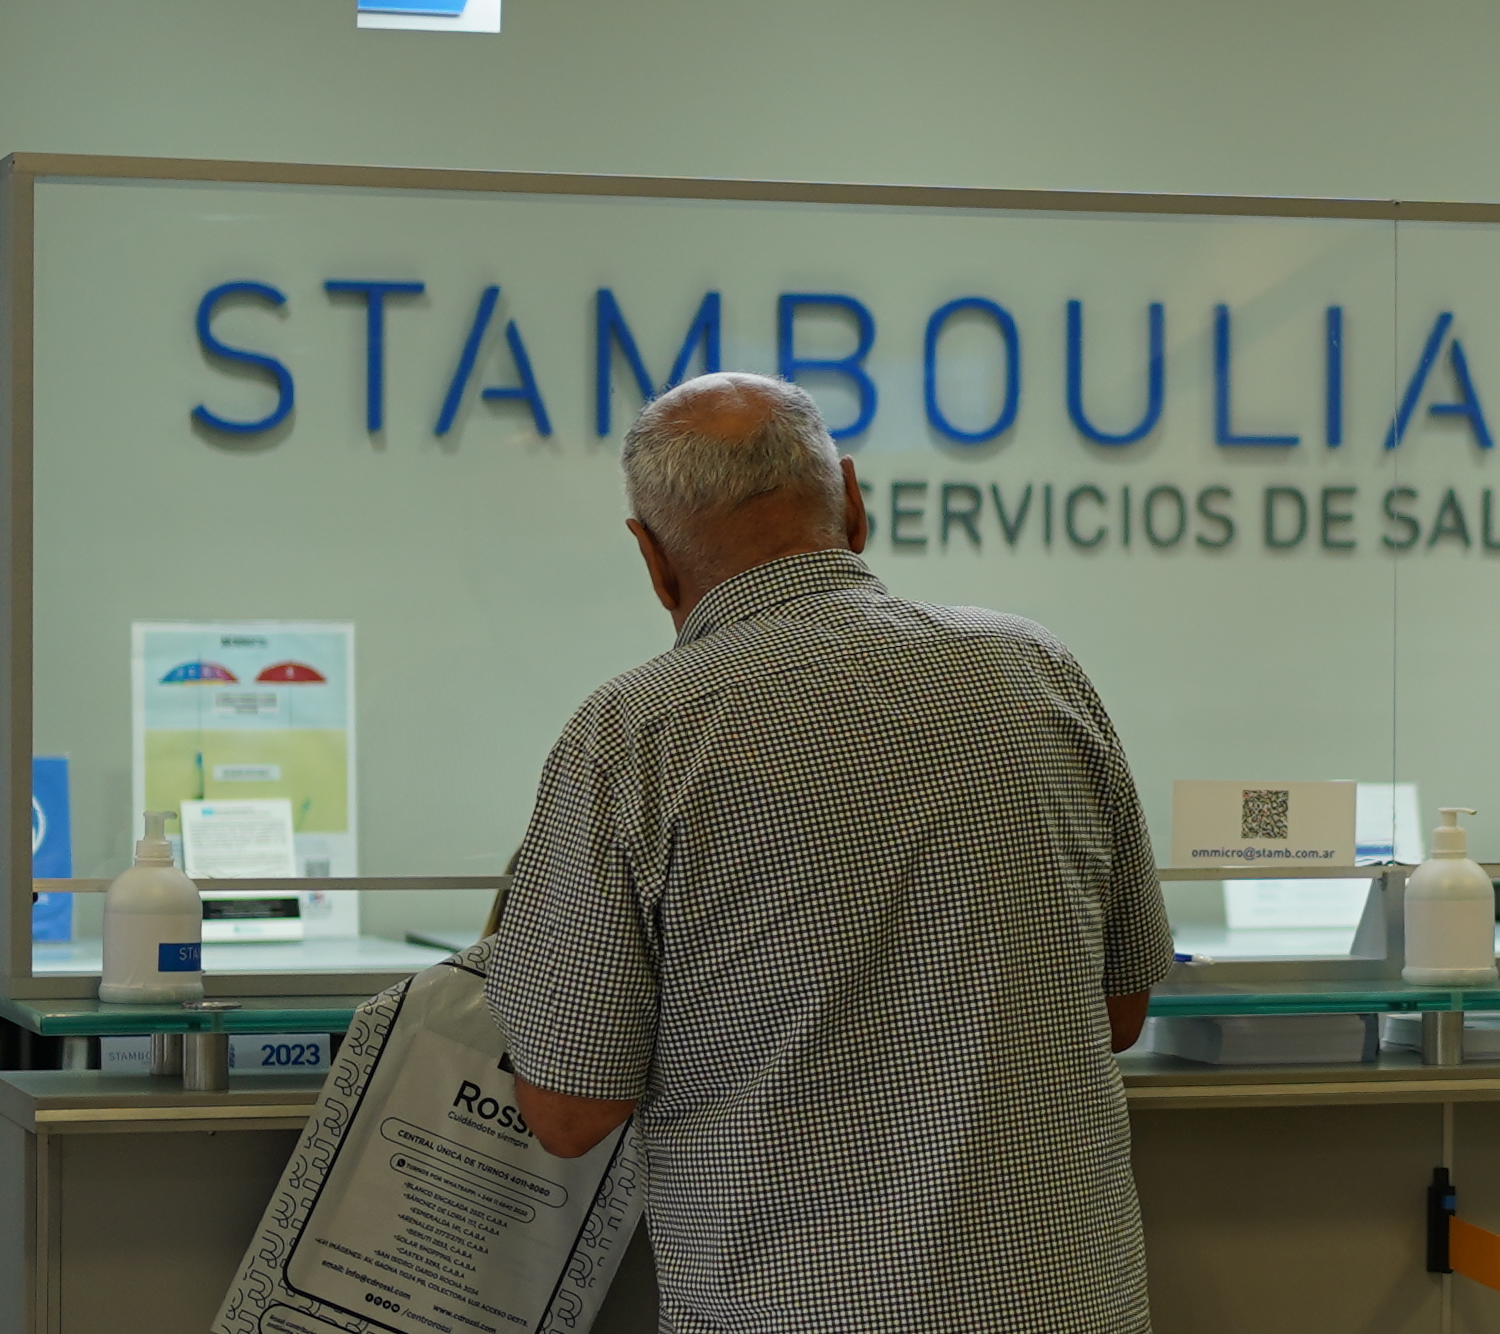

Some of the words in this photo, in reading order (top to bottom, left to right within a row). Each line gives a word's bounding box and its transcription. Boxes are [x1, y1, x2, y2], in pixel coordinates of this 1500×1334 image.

[1264, 485, 1357, 550] DE
[1191, 846, 1335, 861] ommicro@stamb.com.ar
[179, 946, 201, 961] STA
[261, 1043, 320, 1066] 2023
[497, 1131, 529, 1149] siempre
[396, 1128, 436, 1150] CENTRAL
[435, 1142, 464, 1161] ÚNICA
[462, 1155, 476, 1167] DE
[476, 1161, 510, 1181] TURNOS
